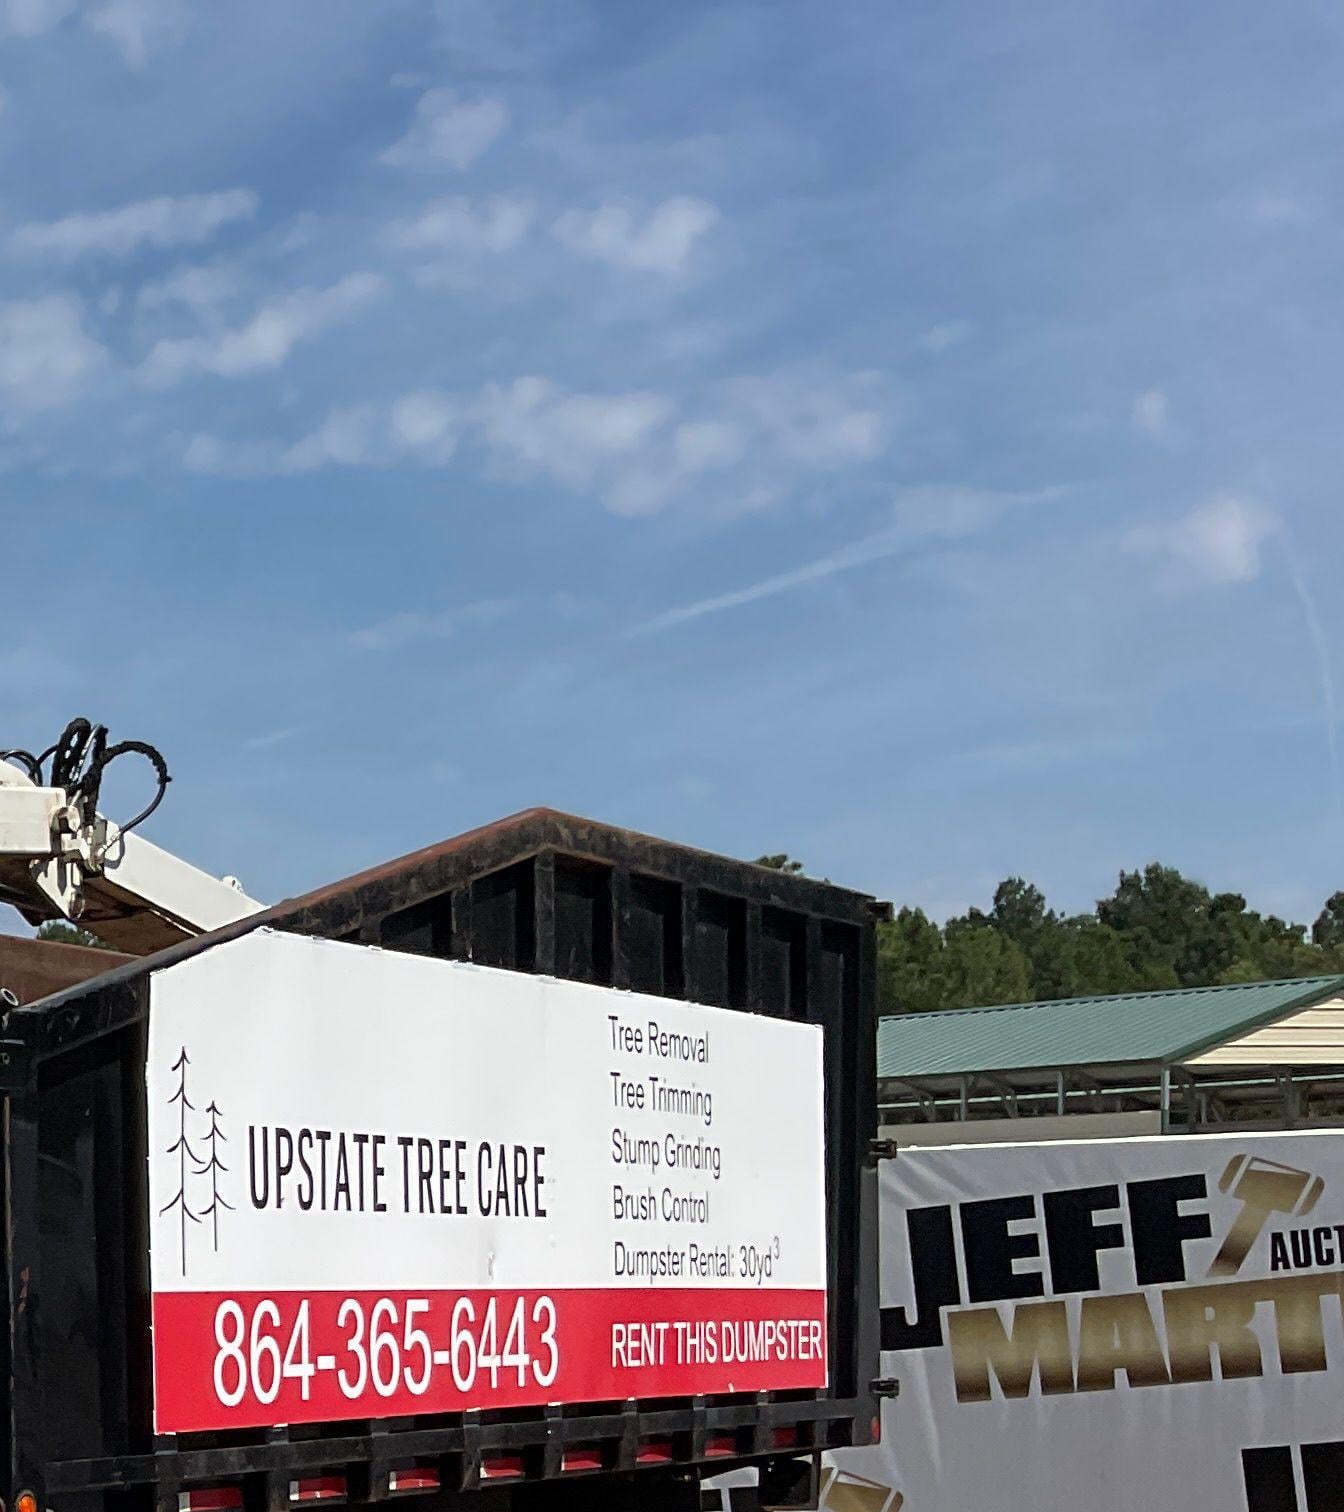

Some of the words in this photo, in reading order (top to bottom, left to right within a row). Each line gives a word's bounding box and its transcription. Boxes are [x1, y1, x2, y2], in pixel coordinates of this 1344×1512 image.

[608, 1015, 643, 1053] Tree
[648, 1021, 709, 1063] Removal
[610, 1072, 645, 1109] Tree
[649, 1076, 712, 1126] Trimming
[249, 1125, 387, 1212] UPSTATE
[397, 1136, 468, 1215] TREE
[477, 1141, 547, 1218] CARE
[612, 1128, 660, 1175] Stump
[664, 1133, 721, 1180] Grinding
[613, 1185, 657, 1220] Brush
[662, 1187, 710, 1223] Control
[614, 1241, 685, 1285] Dumpster
[689, 1243, 735, 1277] Rental:
[881, 1173, 1212, 1351] JEFF
[213, 1295, 559, 1407] 864-365-6443
[612, 1321, 670, 1368] RENT
[673, 1320, 718, 1364] THIS
[721, 1319, 823, 1363] DUMPSTER
[948, 1271, 1344, 1403] MART
